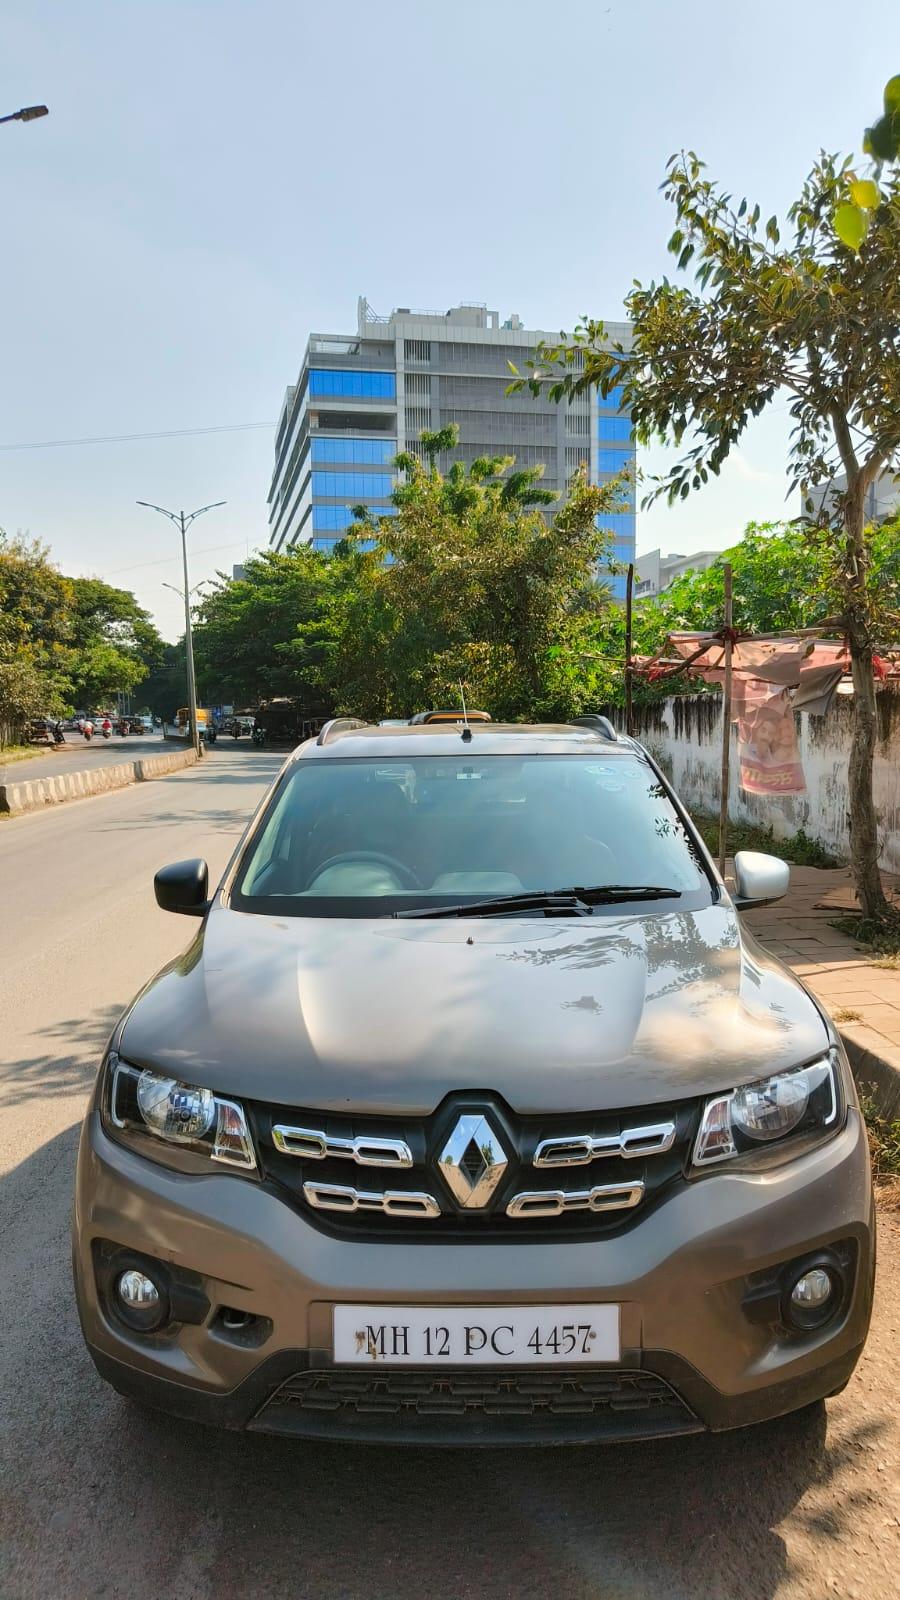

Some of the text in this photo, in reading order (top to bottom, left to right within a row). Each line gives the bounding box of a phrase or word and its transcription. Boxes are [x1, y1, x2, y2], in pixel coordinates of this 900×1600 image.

[366, 1325, 592, 1356] MH 12 PC 4457
